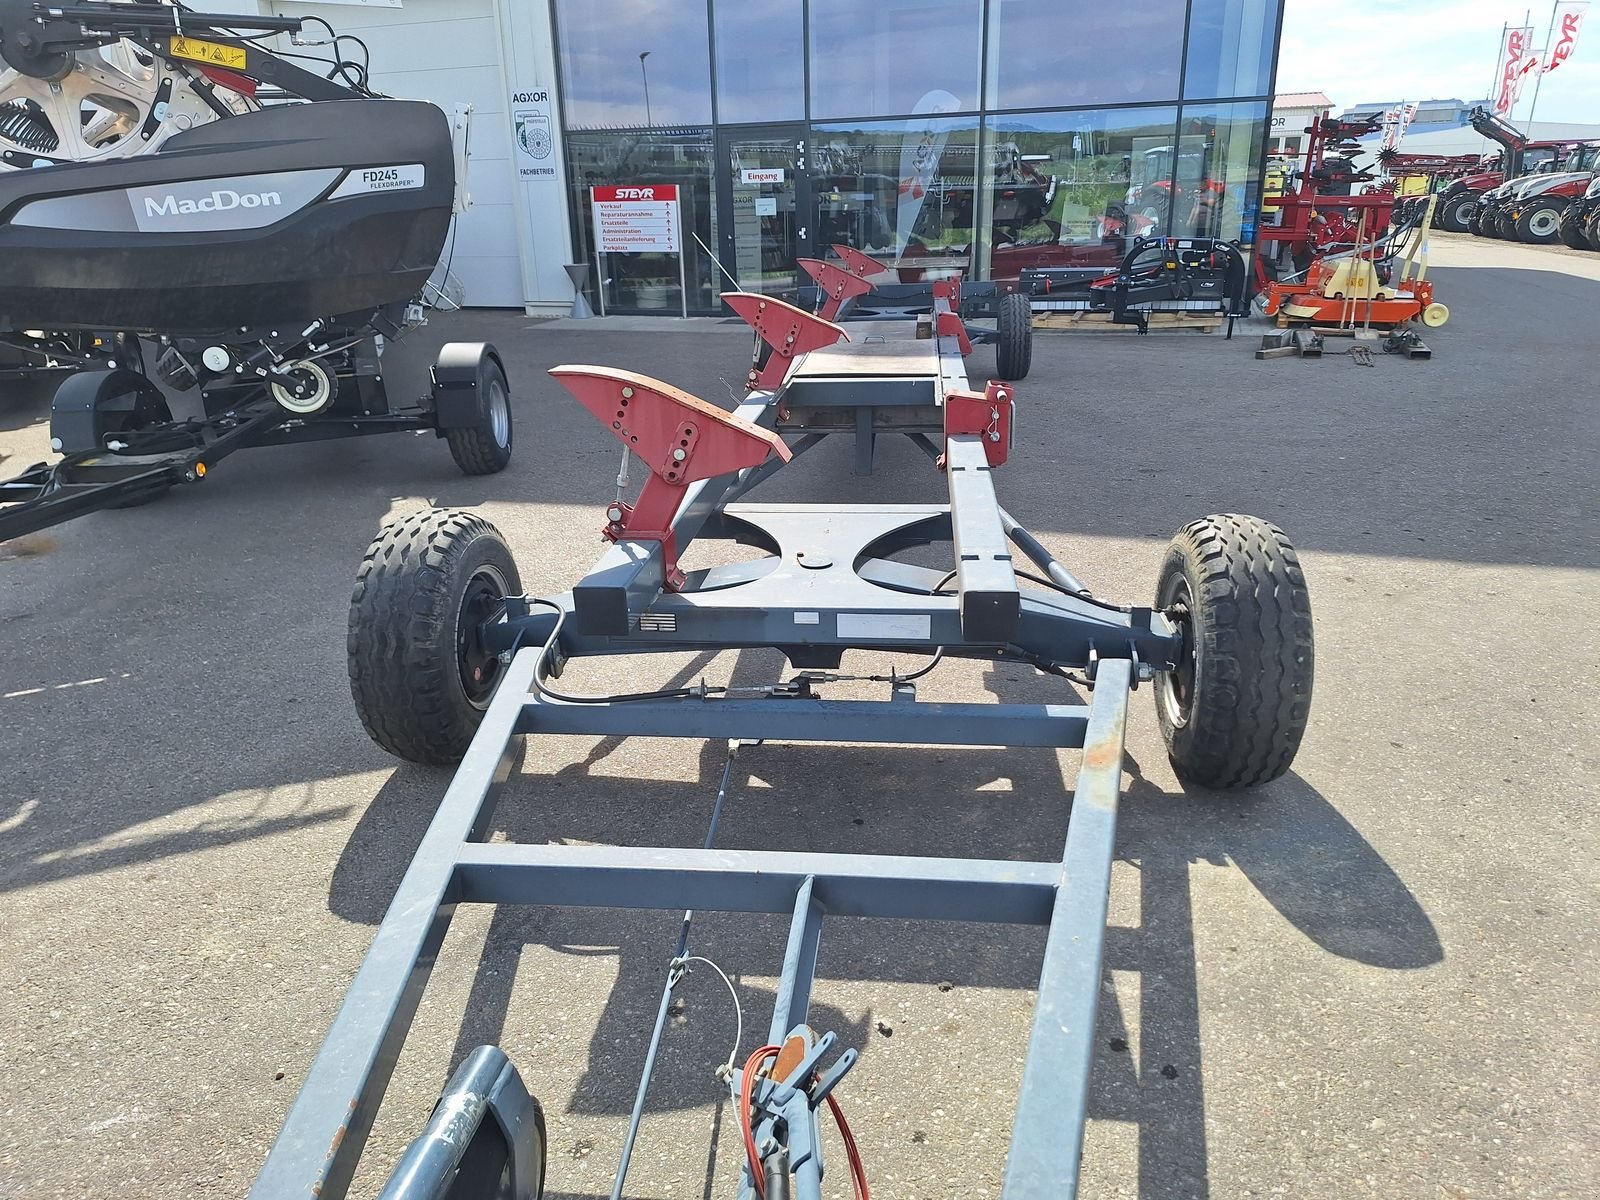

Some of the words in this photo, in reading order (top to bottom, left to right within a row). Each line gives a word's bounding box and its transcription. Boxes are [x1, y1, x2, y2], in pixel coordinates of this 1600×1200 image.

[512, 92, 548, 103] AGXOR
[1270, 117, 1286, 126] OR
[362, 169, 398, 183] FD245
[519, 167, 555, 176] FACHBETRIEB
[747, 172, 778, 182] Eingang
[615, 188, 654, 199] STEYR
[144, 190, 282, 217] MacDon
